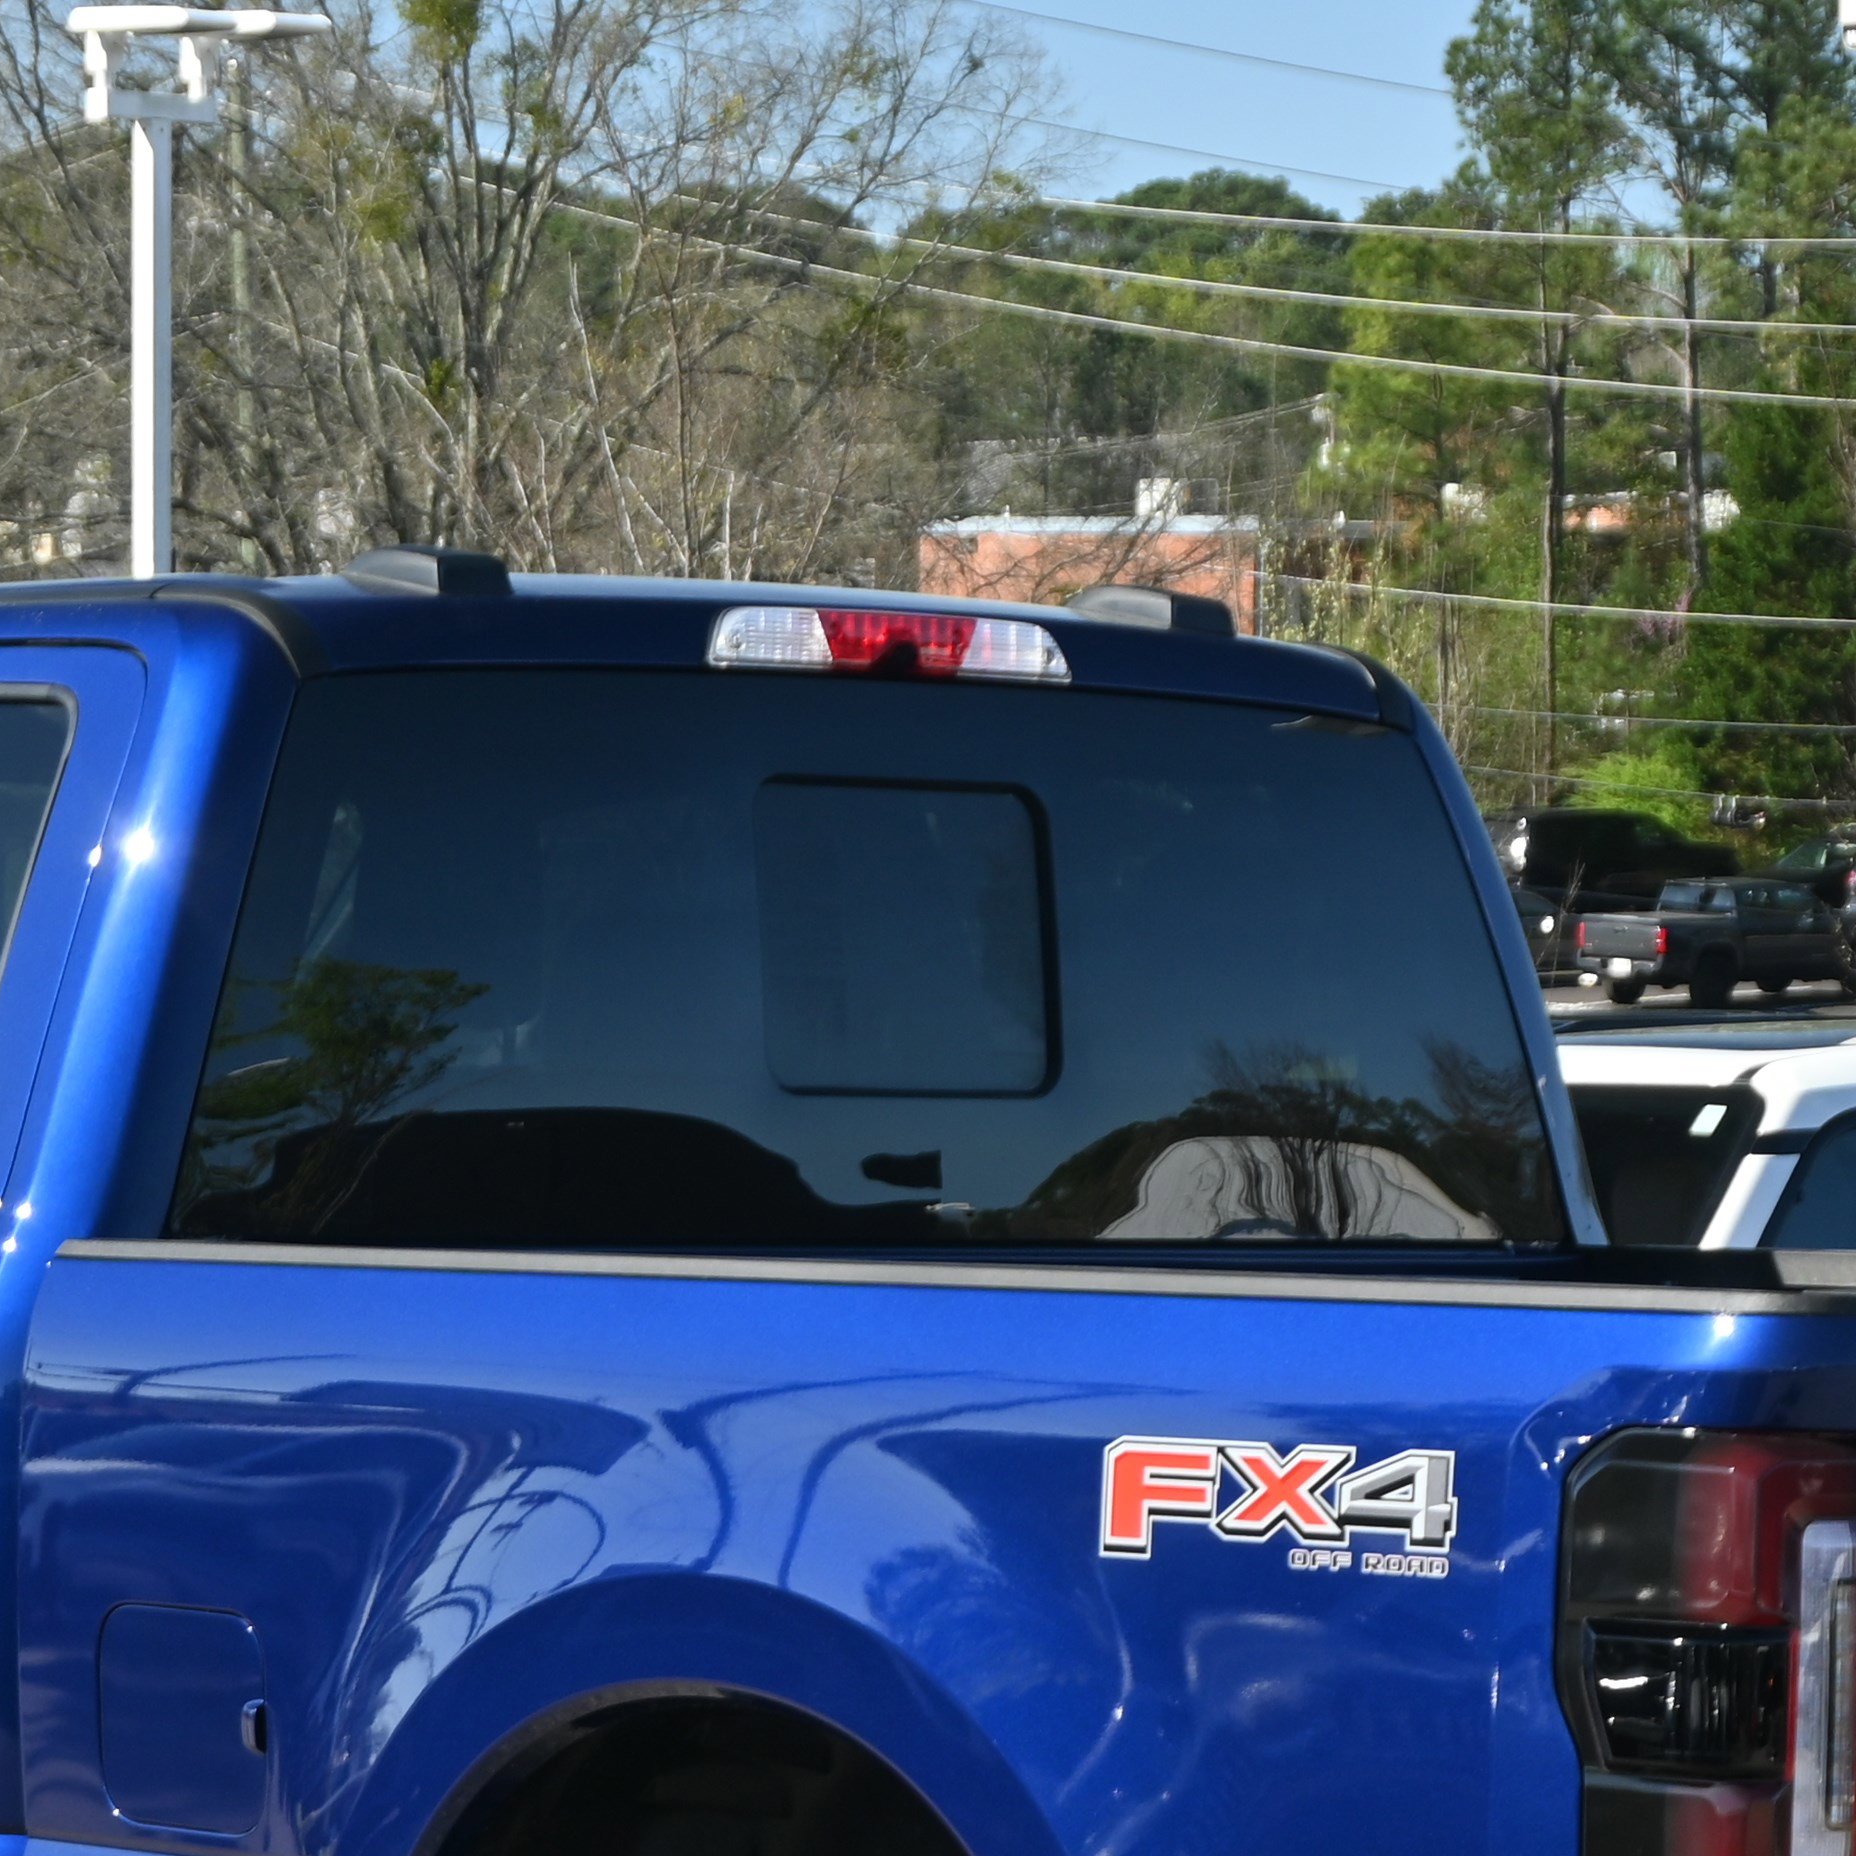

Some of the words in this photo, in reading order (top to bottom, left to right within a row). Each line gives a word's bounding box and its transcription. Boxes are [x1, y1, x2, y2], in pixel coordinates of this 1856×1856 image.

[1099, 1435, 1458, 1559] FX4
[1288, 1548, 1352, 1573] OFF
[1361, 1554, 1449, 1578] ROAD
